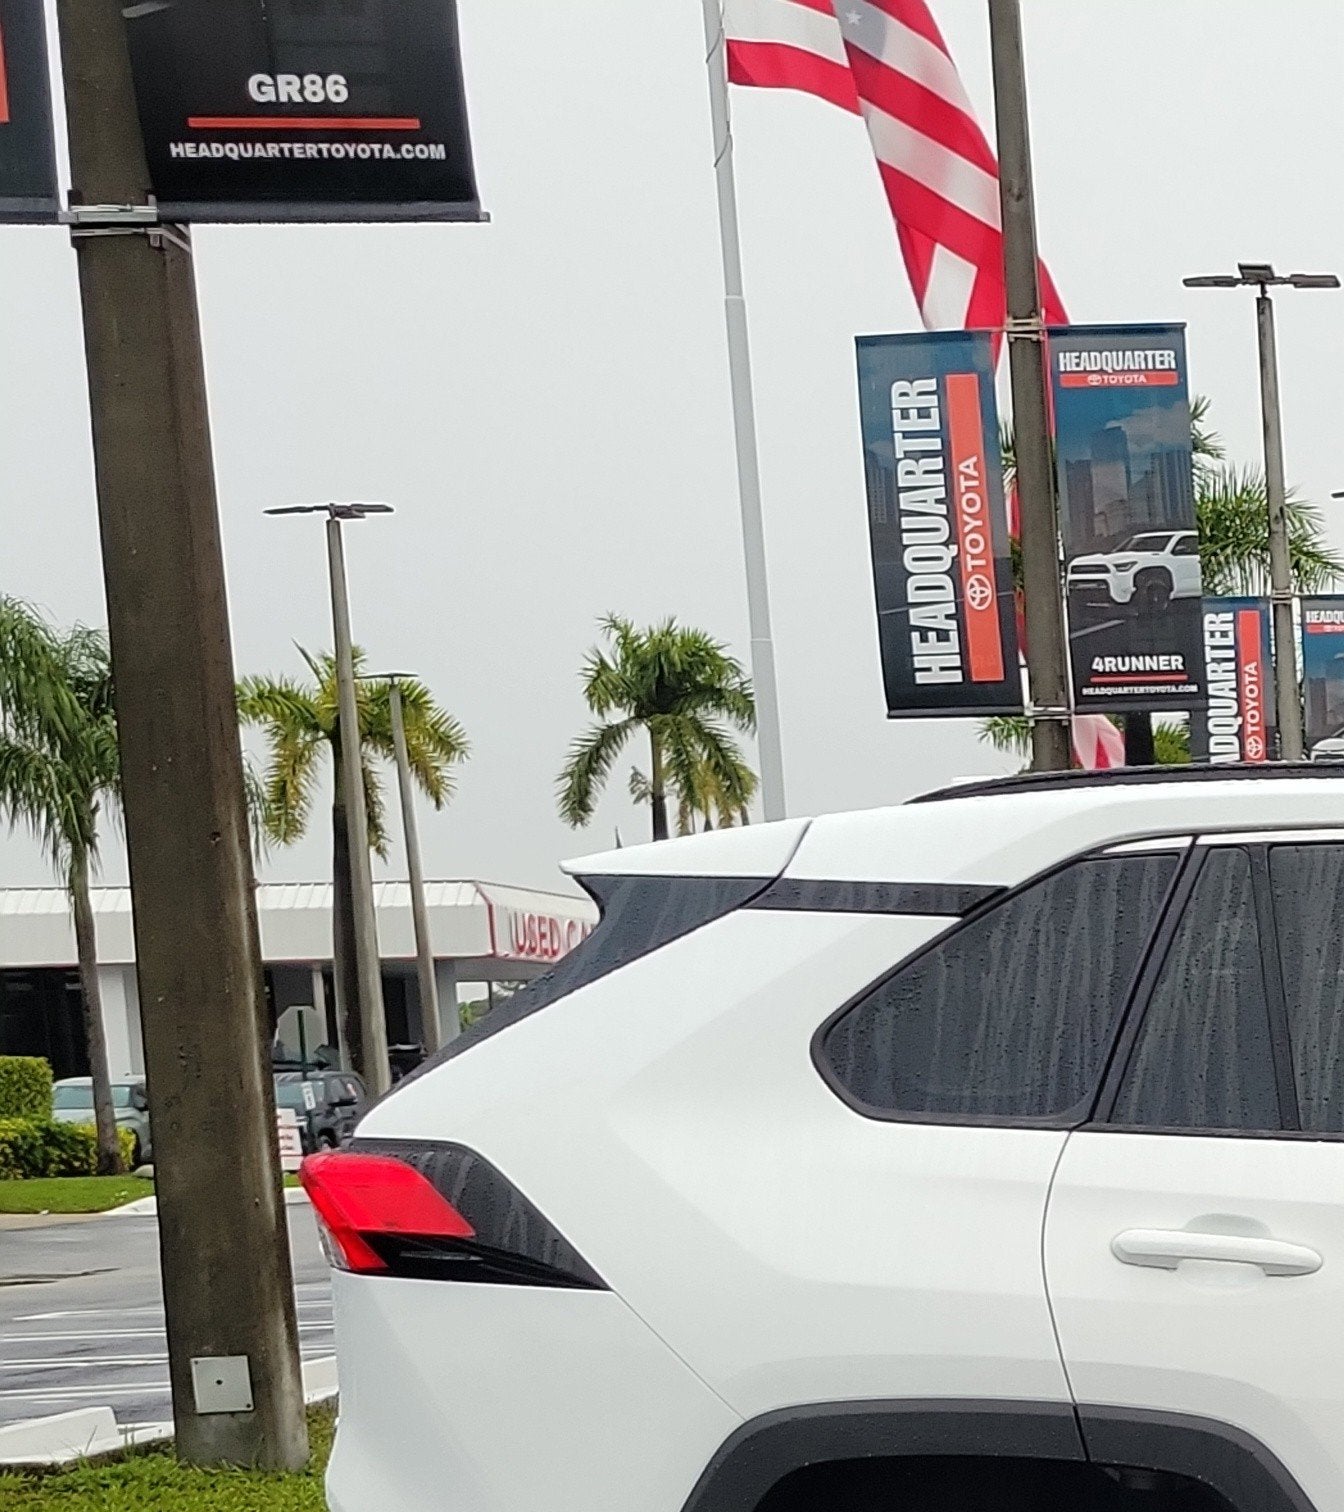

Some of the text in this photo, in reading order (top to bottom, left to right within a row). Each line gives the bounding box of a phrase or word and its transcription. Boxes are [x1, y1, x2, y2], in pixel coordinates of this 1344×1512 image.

[248, 73, 349, 103] GR86
[170, 142, 446, 161] HEADQUARTERTOYOTA.COM
[1058, 350, 1177, 373] HEADQUARTER
[1102, 374, 1148, 384] TOYOTA
[891, 377, 964, 685] HEADQUARTER
[957, 455, 987, 573] TOYOTA
[1091, 655, 1185, 672] 4RUNNER
[1203, 612, 1243, 764] ADQUARTER
[1244, 661, 1260, 734] TOYOTA
[509, 910, 561, 958] USED
